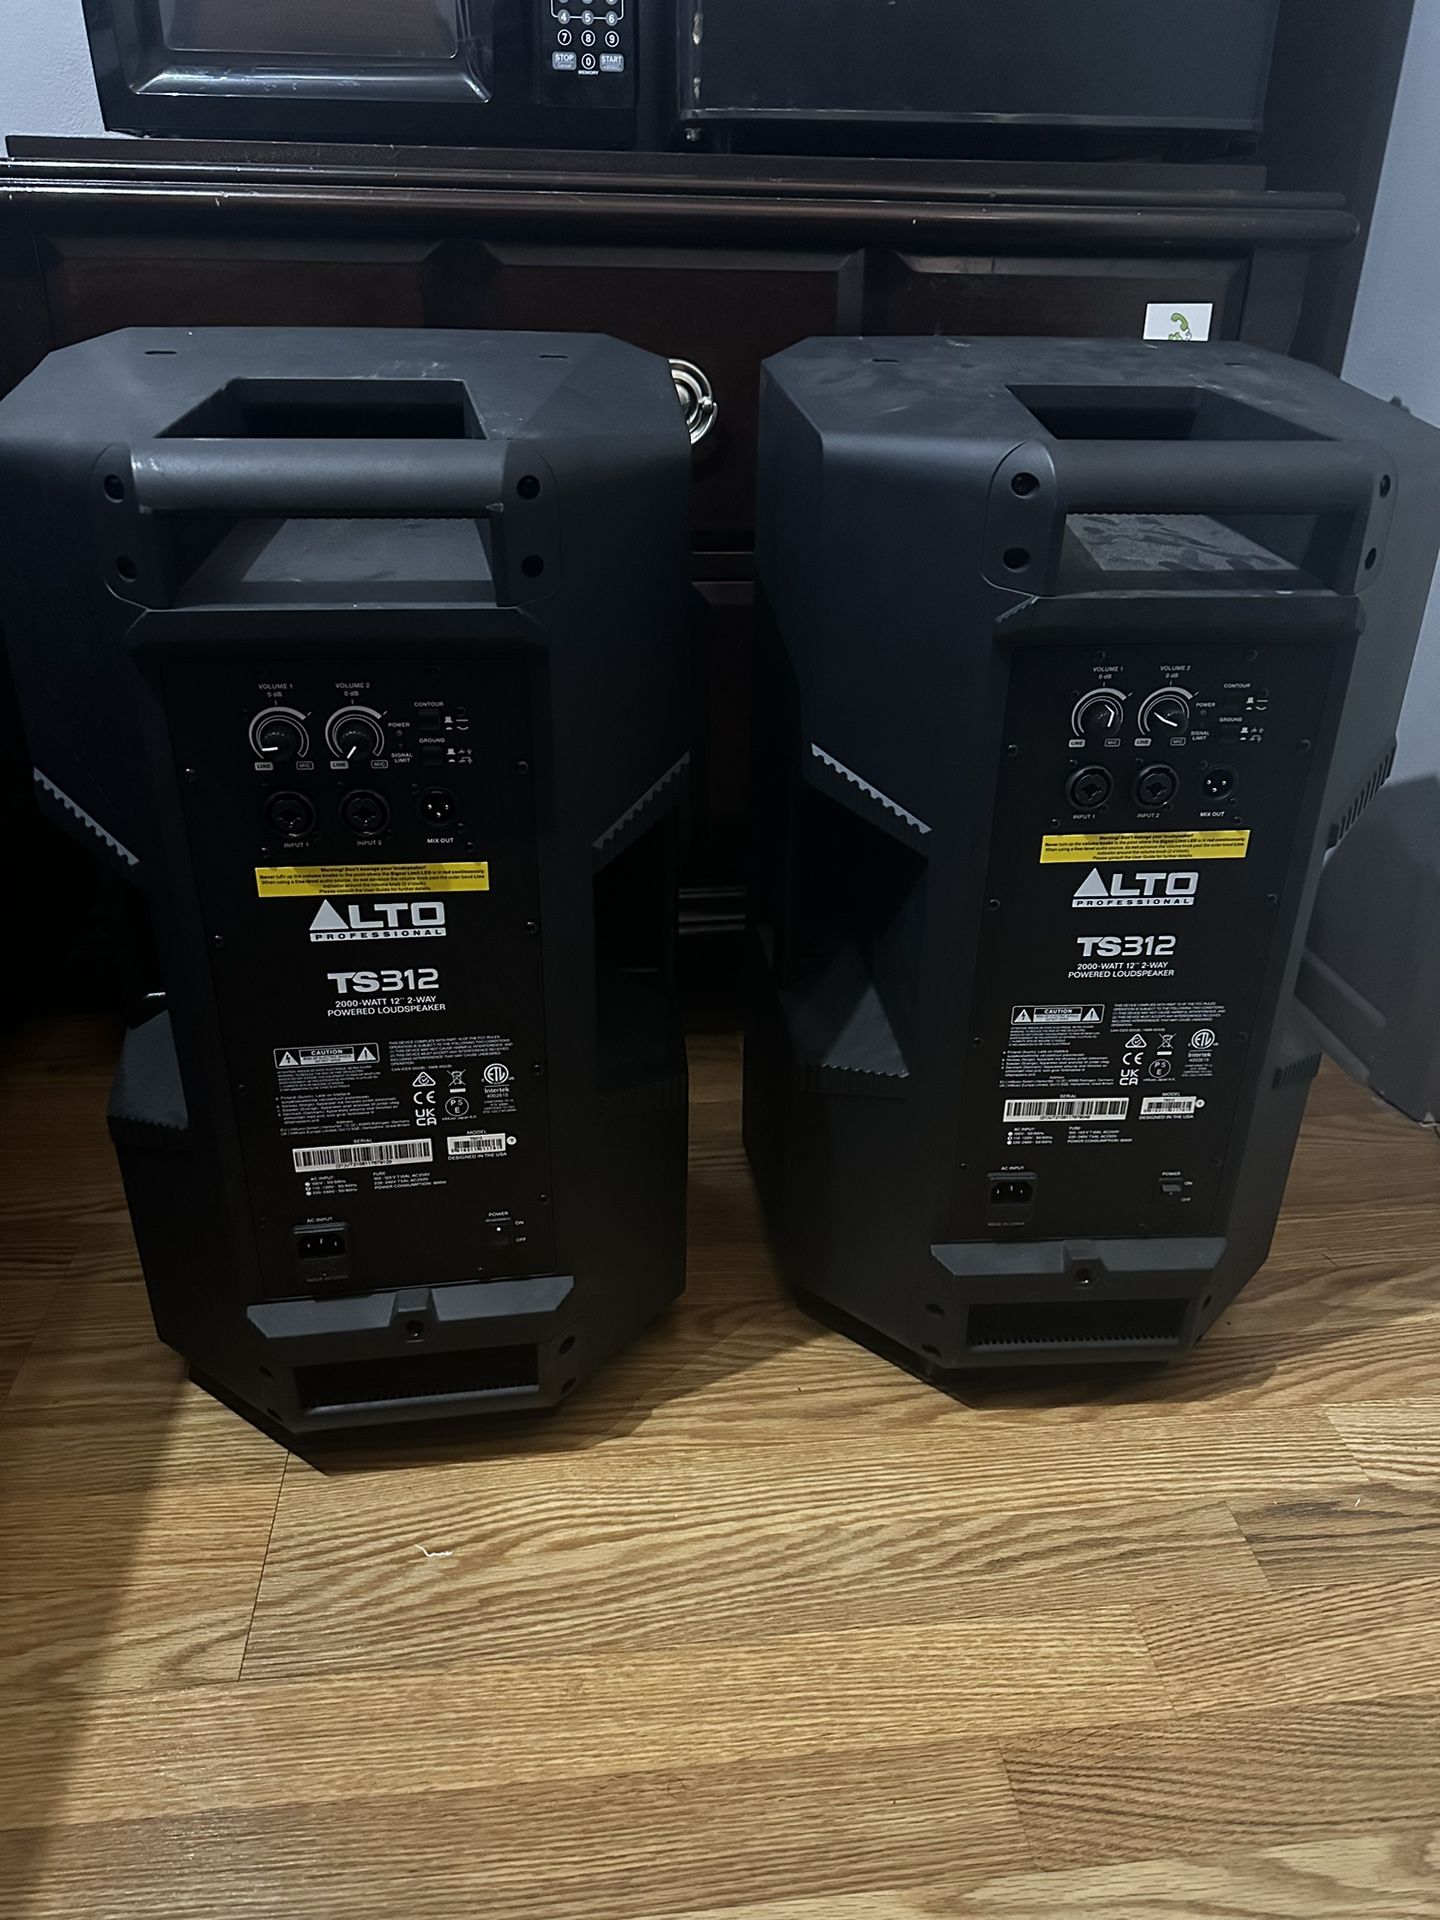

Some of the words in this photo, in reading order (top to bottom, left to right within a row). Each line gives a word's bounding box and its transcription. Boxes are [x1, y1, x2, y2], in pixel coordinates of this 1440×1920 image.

[560, 11, 567, 22] 4
[584, 12, 591, 22] 5
[608, 13, 615, 24] 6
[561, 32, 568, 42] 7
[585, 33, 592, 43] 8
[608, 34, 616, 44] 9
[555, 53, 574, 61] STOP
[601, 55, 622, 63] START
[1093, 665, 1119, 673] VOLUME
[1160, 664, 1186, 672] VOLUME
[258, 683, 288, 691] VOLUME
[335, 682, 364, 690] VOLUME
[314, 929, 443, 941] PROFESSIONAL
[1077, 936, 1177, 957] TS312
[1068, 971, 1111, 979] POWERED
[1112, 969, 1175, 978] LOUDSPEAKER
[327, 968, 439, 993] TS312
[335, 997, 387, 1009] 2000-WATT
[407, 995, 437, 1004] 2-WAY
[327, 1007, 375, 1017] POWERED
[377, 1003, 446, 1015] LOUDSPEAKER
[1120, 1069, 1140, 1077] UK
[1119, 1077, 1139, 1086] CA
[413, 1091, 436, 1105] CE
[415, 1108, 436, 1118] UK
[415, 1117, 438, 1127] CA
[448, 1153, 477, 1161] DESIGNED
